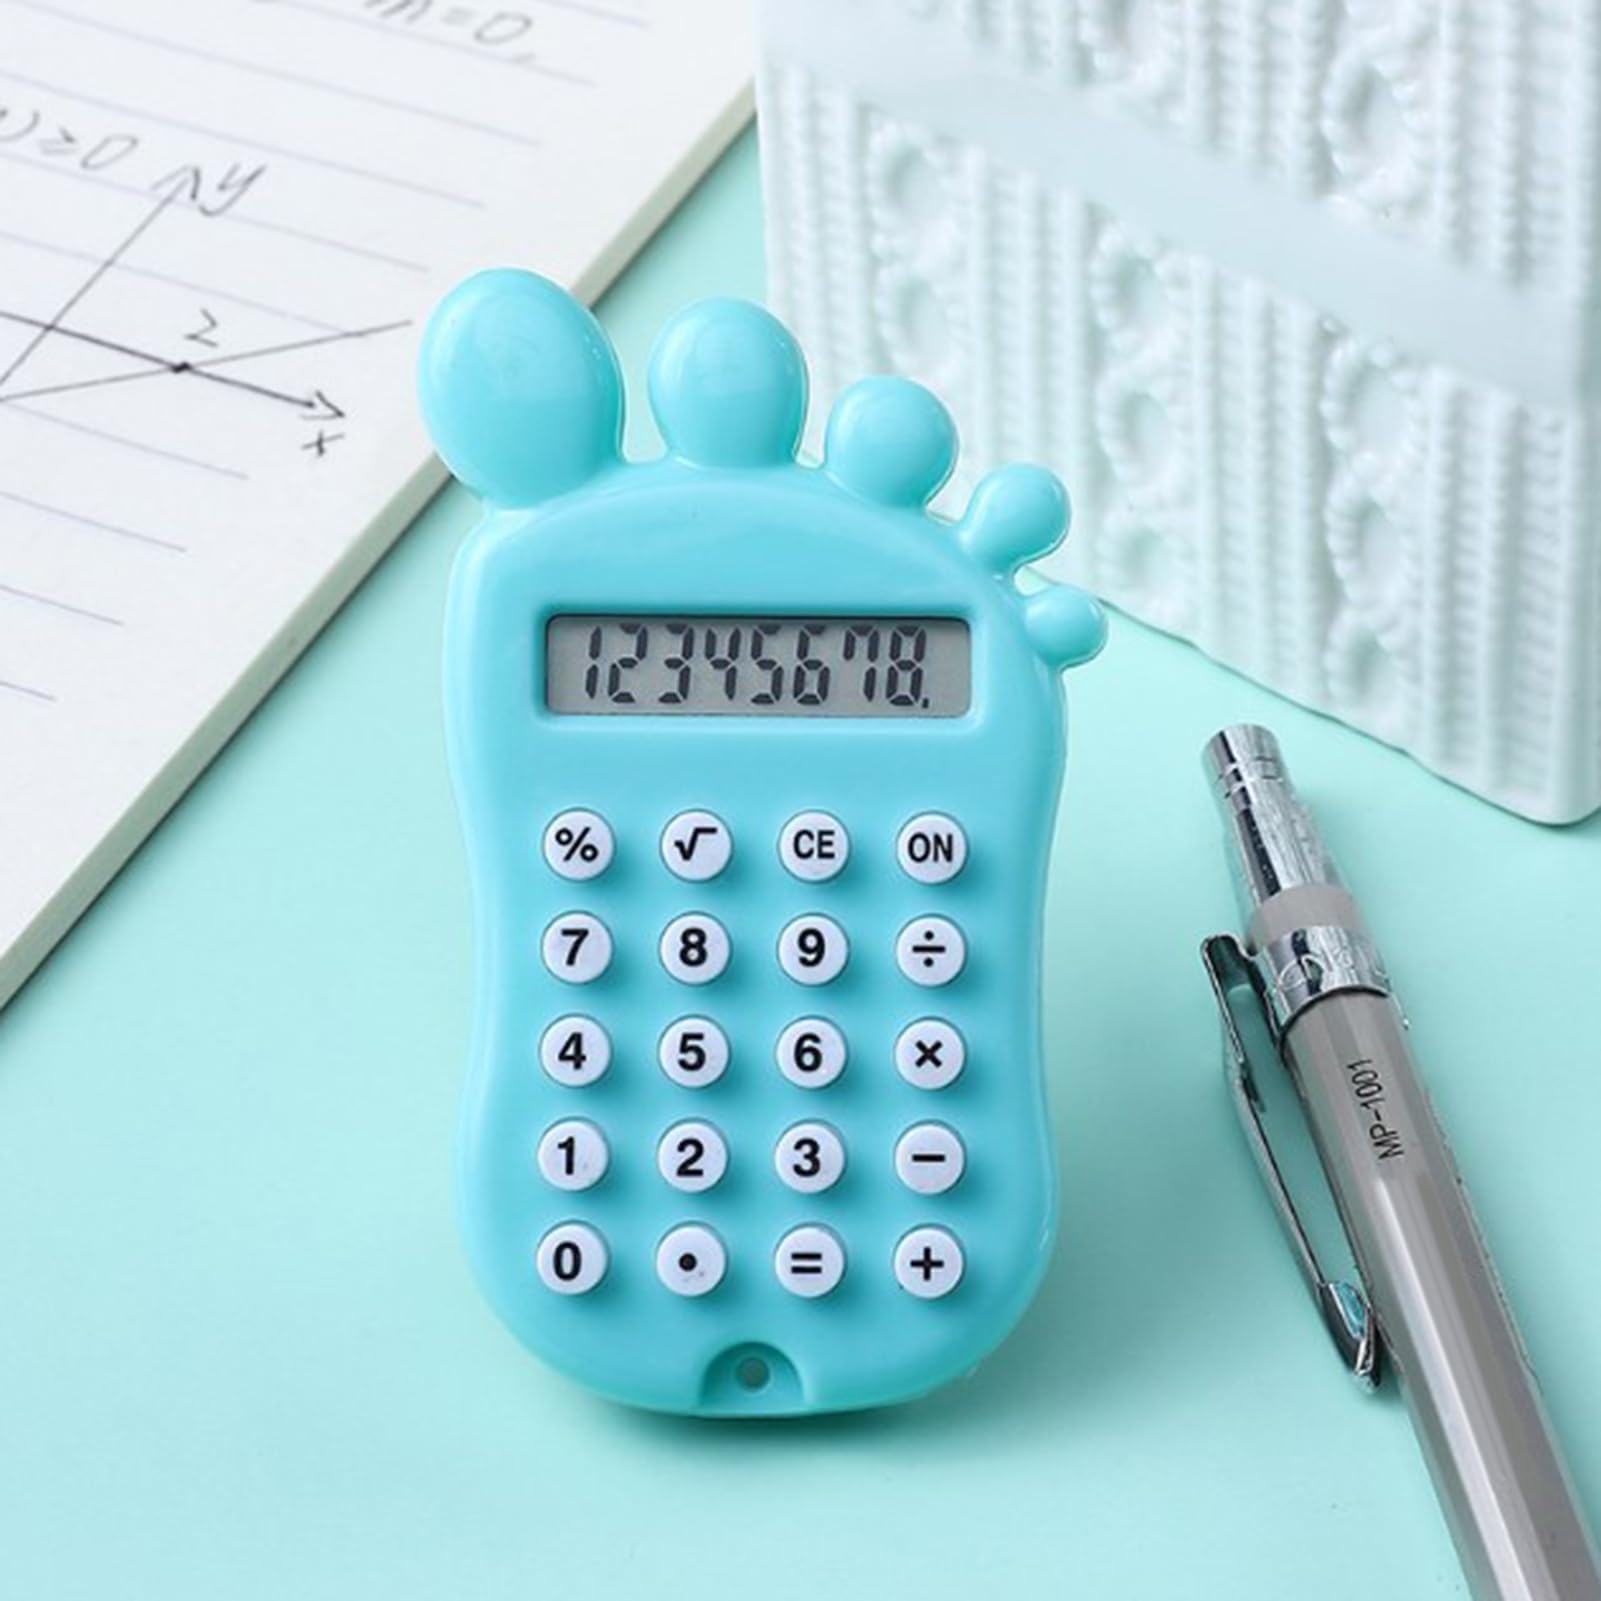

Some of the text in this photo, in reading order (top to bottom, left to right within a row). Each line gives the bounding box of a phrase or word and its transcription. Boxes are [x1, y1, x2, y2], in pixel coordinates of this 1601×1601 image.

[793, 828, 836, 860] CE
[907, 831, 954, 864] ON
[560, 927, 590, 967] 7
[678, 927, 708, 968] 8
[797, 927, 826, 968] 9
[557, 1031, 587, 1071] 4
[677, 1032, 707, 1072] 5
[793, 1032, 823, 1073] 6
[1346, 1059, 1405, 1160] MP-1001
[557, 1135, 575, 1176] 1
[675, 1137, 705, 1178] 2
[792, 1137, 821, 1178] 3
[552, 1240, 583, 1282] 0
